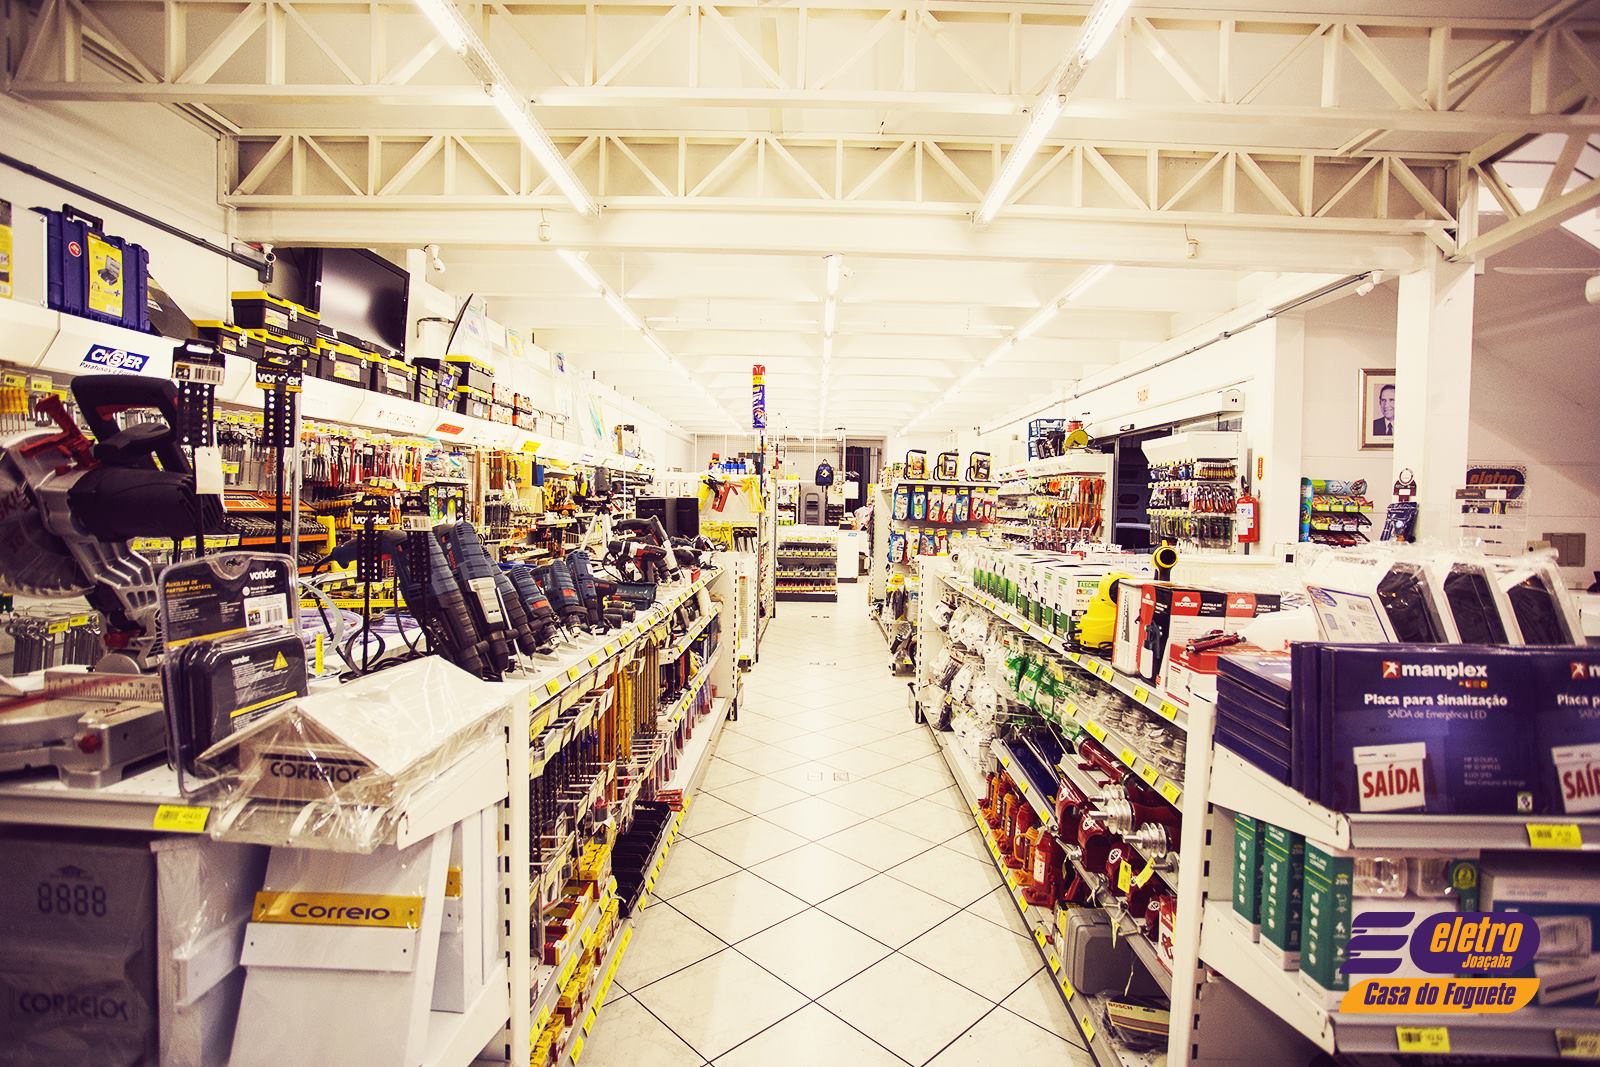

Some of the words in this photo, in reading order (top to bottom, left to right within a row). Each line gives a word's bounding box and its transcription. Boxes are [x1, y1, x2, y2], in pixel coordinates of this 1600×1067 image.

[354, 514, 390, 525] voder
[249, 568, 277, 580] vonder
[1401, 661, 1487, 680] manplex
[1364, 693, 1399, 705] Placa
[1403, 696, 1433, 708] para
[1437, 695, 1508, 709] Sinalização
[1556, 693, 1588, 706] Placa
[1387, 708, 1413, 719] SAÍDA
[1413, 710, 1424, 719] de
[1426, 710, 1468, 721] Emergência
[1470, 710, 1487, 719] LED
[1362, 764, 1420, 798] SAÍDA
[38, 881, 108, 917] 8888
[290, 903, 390, 921] Correio
[20, 992, 129, 1021] CORREIOS
